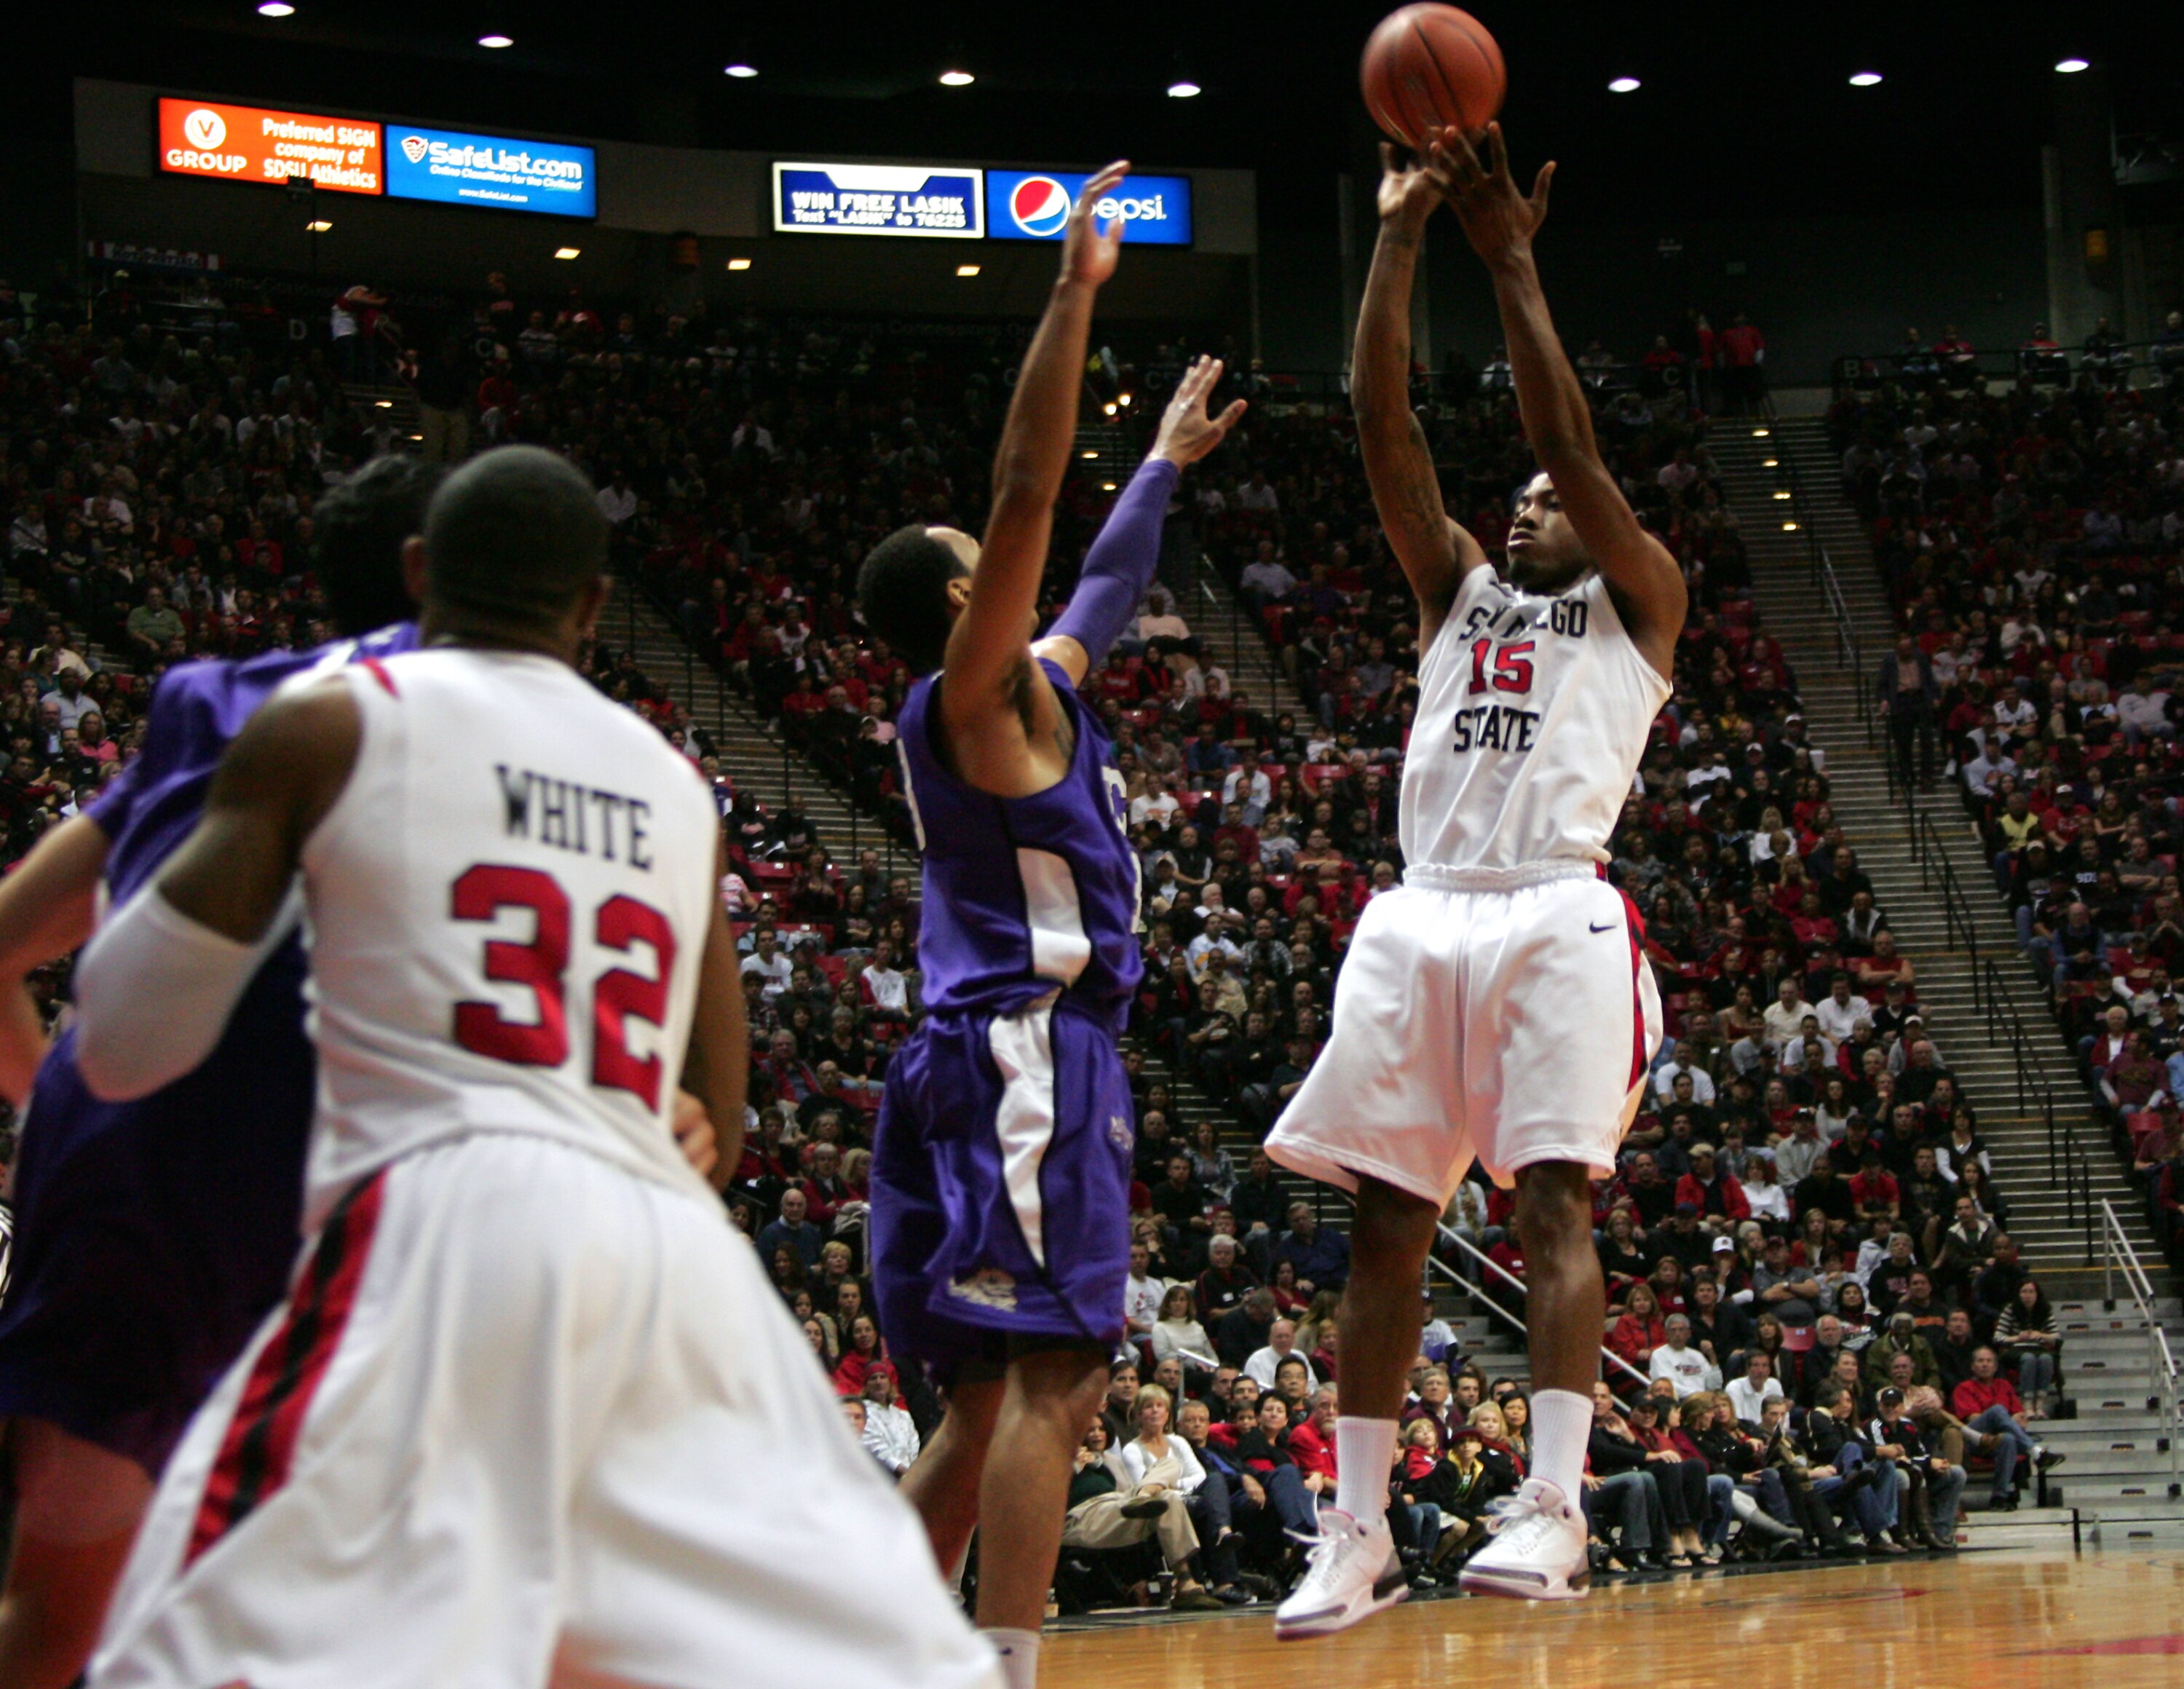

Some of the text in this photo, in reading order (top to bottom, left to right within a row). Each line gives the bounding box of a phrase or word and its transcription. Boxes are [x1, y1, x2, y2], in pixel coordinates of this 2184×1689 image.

[263, 117, 376, 148] Preferred SIGN
[166, 149, 247, 173] GROUP
[274, 142, 365, 165] company of
[429, 141, 582, 179] SafeList.com
[309, 163, 376, 189] Athletics
[512, 174, 526, 185] for
[791, 191, 965, 215] WIN FREE LASIK
[792, 209, 826, 224] Text
[895, 213, 913, 226] to
[1080, 194, 1167, 224] epsi
[1468, 638, 1536, 695] 15
[1454, 704, 1540, 753] STATE
[494, 763, 653, 872] WHITE
[450, 863, 678, 1116] 32
